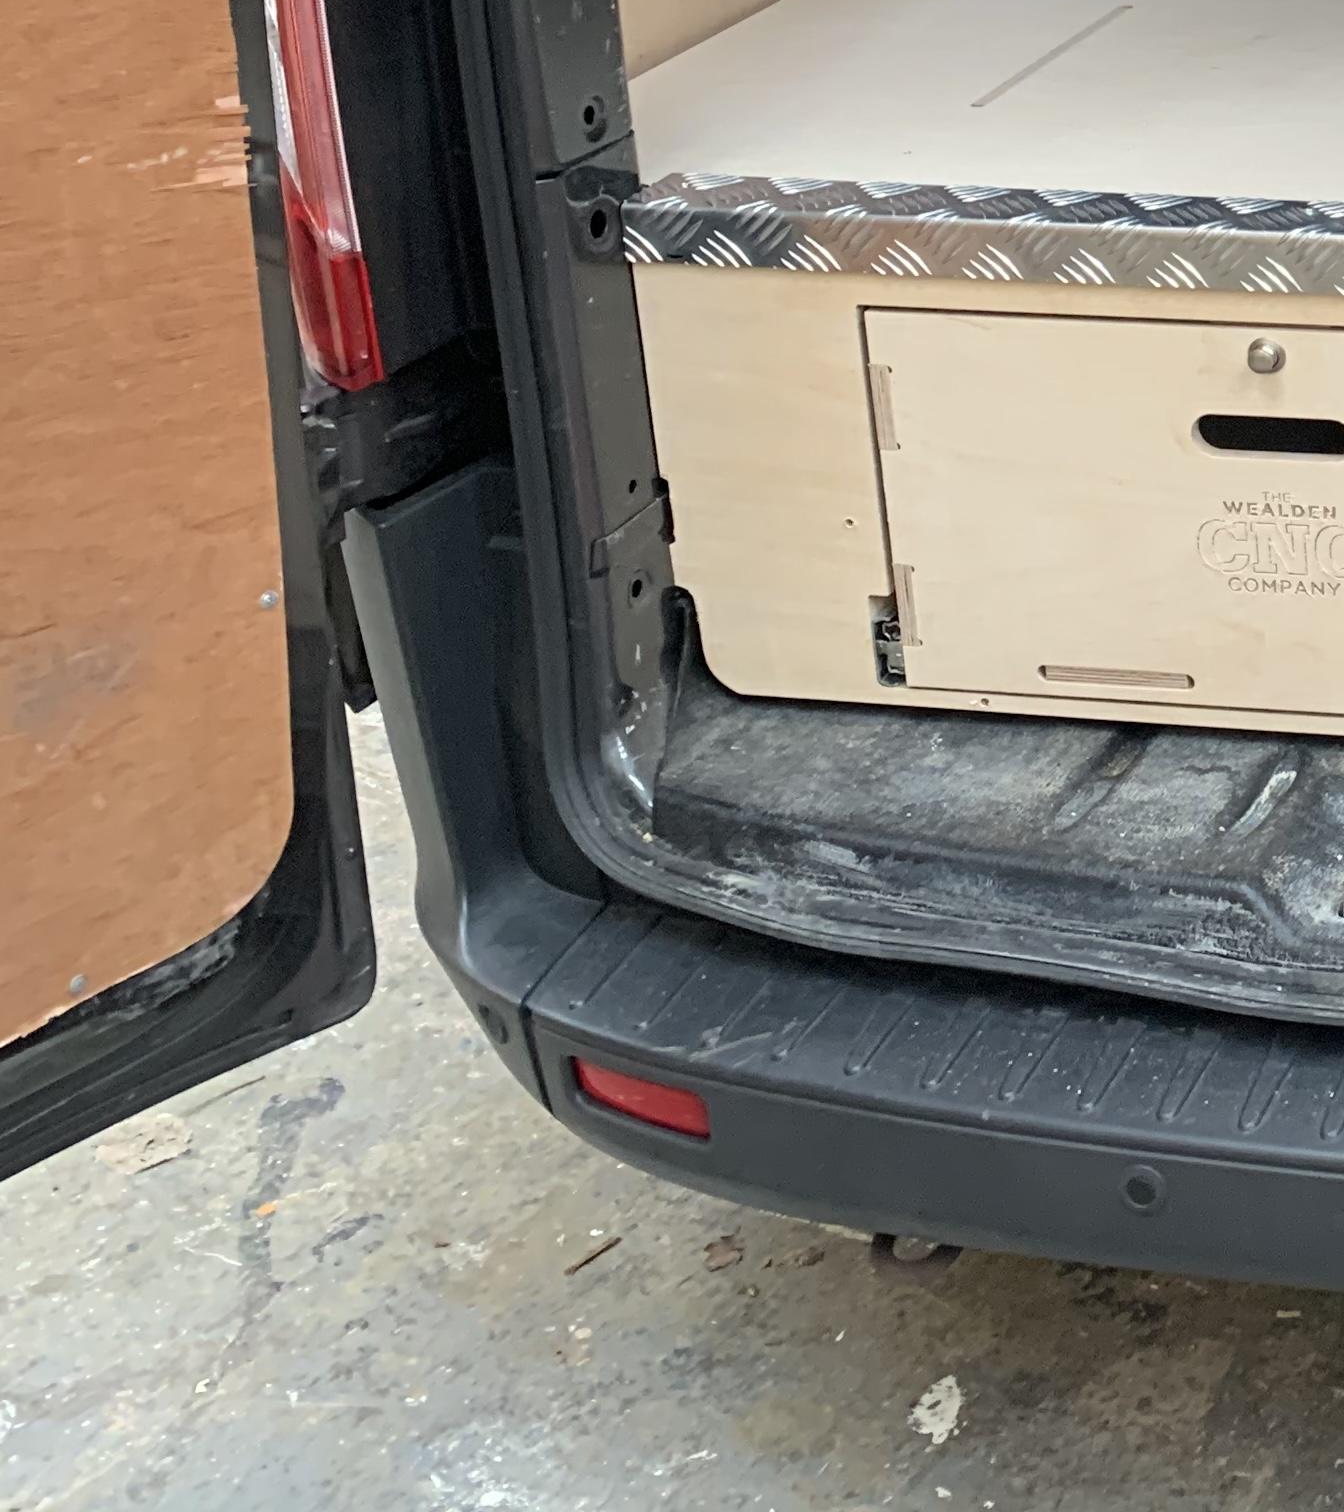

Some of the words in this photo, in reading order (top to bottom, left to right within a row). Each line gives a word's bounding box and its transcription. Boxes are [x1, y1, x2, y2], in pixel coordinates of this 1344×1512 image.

[1262, 491, 1291, 503] THE
[1223, 501, 1336, 519] WEALDEN
[1228, 577, 1341, 596] COMPANY
